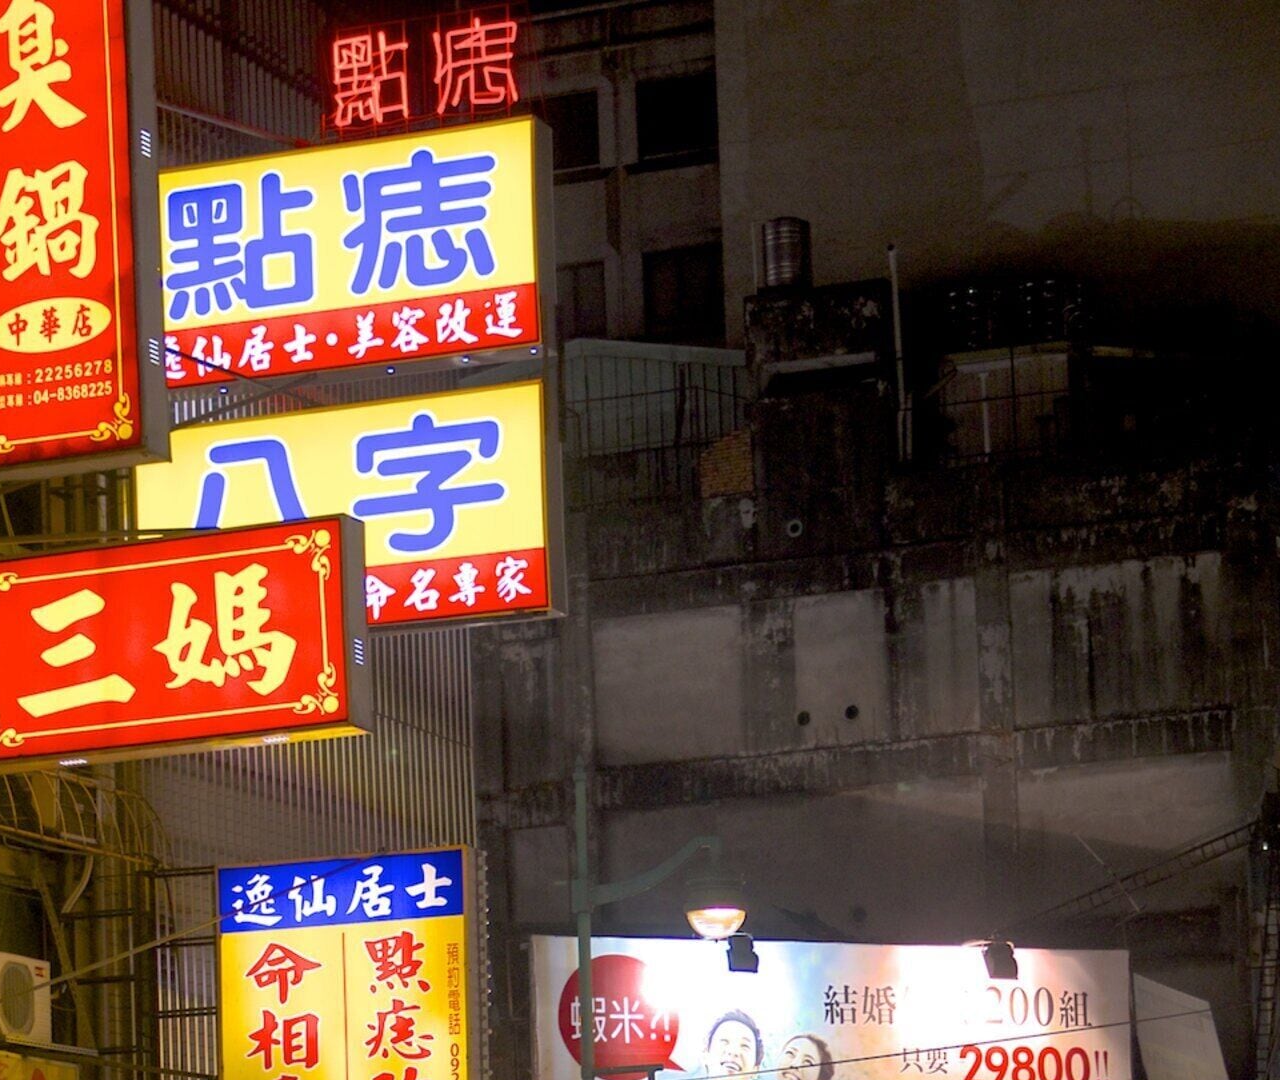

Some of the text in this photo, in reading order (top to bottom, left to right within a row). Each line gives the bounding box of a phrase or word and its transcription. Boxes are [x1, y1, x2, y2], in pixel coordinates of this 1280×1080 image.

[332, 17, 519, 128] 點痣
[164, 148, 497, 321] 點痣
[8, 303, 93, 347] 中華店
[192, 413, 507, 553] 八字
[17, 562, 298, 719] 三媽
[365, 555, 533, 622] 命名專家
[231, 863, 453, 928] 逸仙居士
